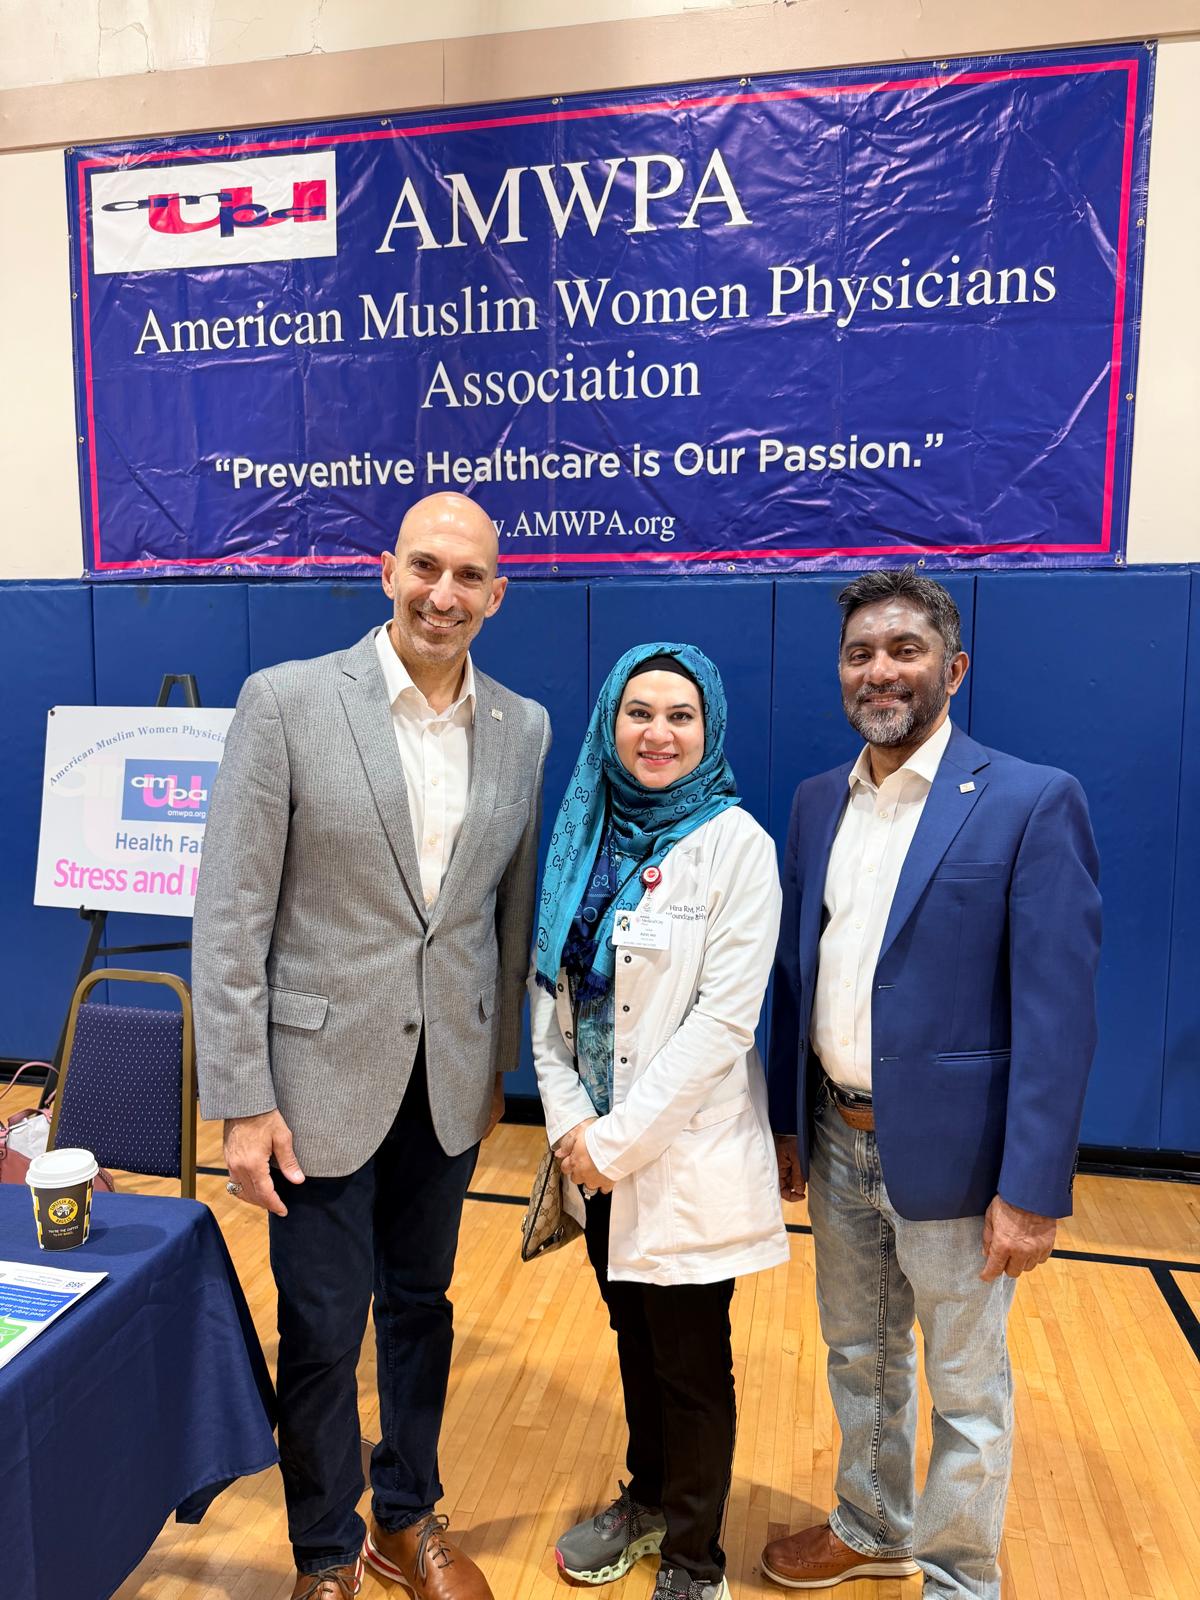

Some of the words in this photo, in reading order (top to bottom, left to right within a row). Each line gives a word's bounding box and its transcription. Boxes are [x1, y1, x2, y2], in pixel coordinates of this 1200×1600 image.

[376, 148, 753, 254] AMWPA
[134, 300, 344, 356] American
[359, 285, 539, 341] Muslim
[554, 277, 749, 329] Women
[768, 255, 1057, 328] Physicians
[421, 350, 701, 409] Association
[215, 453, 415, 490] “Preventive
[427, 446, 620, 484] Healthcare
[634, 453, 660, 478] is
[673, 441, 746, 476] Our
[758, 433, 944, 474] Passion.”
[50, 747, 94, 786] American
[96, 730, 135, 751] Muslim
[138, 725, 178, 736] Women
[115, 832, 173, 853] Health
[54, 858, 128, 892] Stress
[132, 864, 185, 896] and
